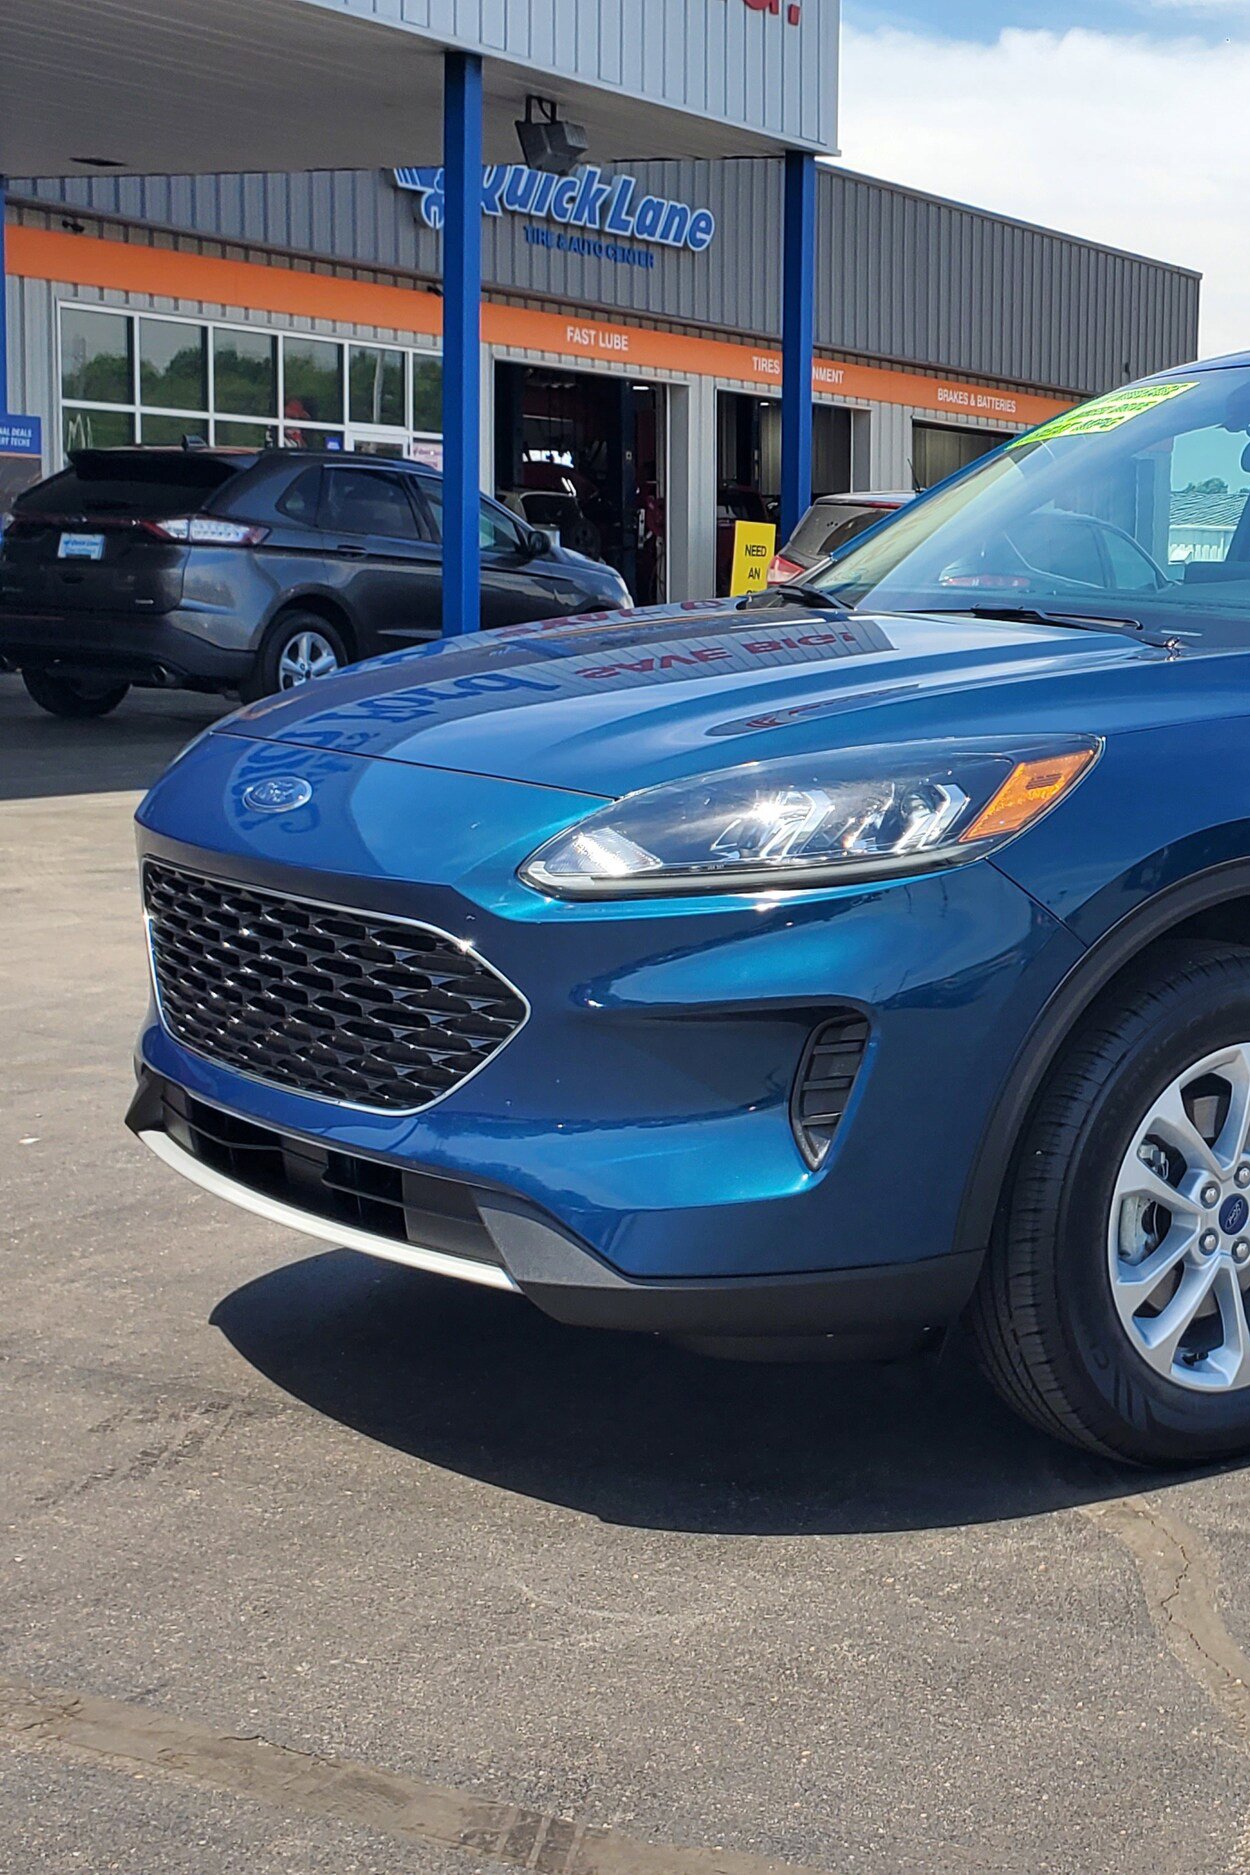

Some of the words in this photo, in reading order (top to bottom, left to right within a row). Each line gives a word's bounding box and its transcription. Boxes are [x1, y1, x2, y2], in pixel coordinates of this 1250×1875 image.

[523, 225, 552, 248] TIRE
[556, 232, 567, 250] &
[569, 236, 602, 259] AUTO
[605, 242, 654, 269] CENTER
[566, 325, 596, 346] FAST
[599, 331, 629, 351] LUBE
[752, 356, 781, 375] TIRES
[811, 366, 844, 384] NMENT
[937, 387, 968, 405] BRAKES
[970, 393, 976, 406] &
[976, 395, 1016, 413] BATTERIES
[744, 544, 767, 557] NEED
[748, 567, 761, 580] AN
